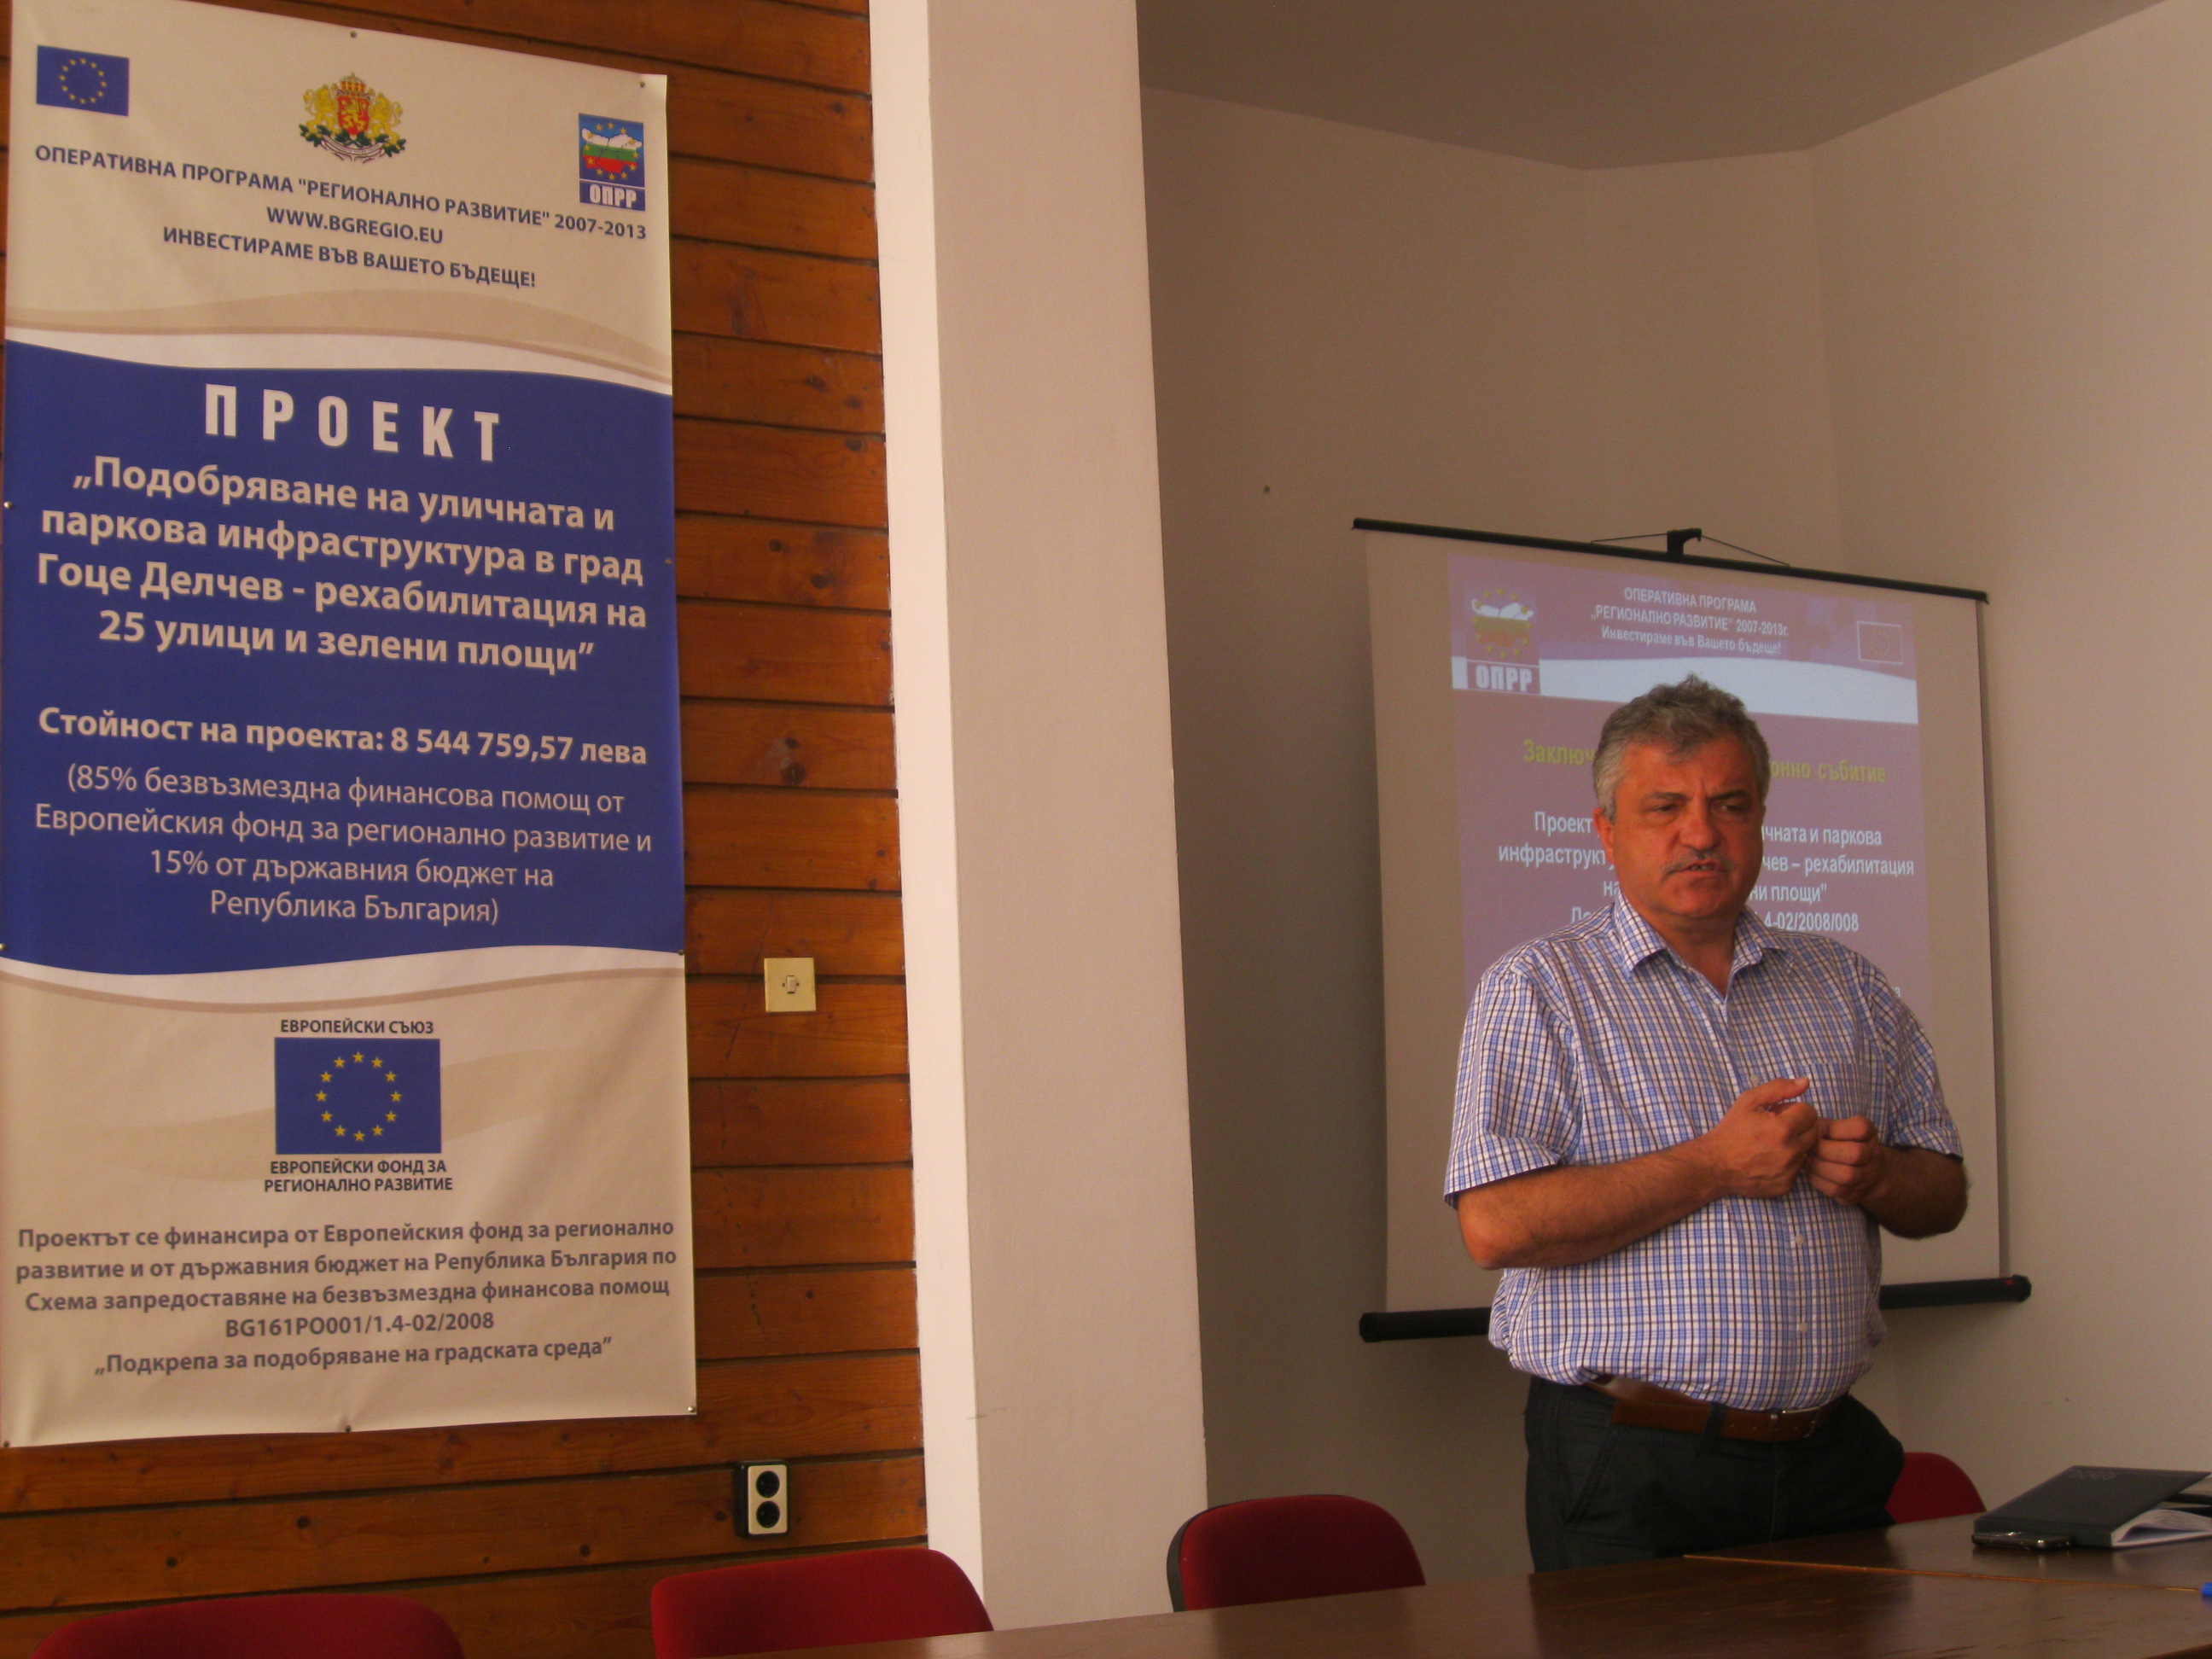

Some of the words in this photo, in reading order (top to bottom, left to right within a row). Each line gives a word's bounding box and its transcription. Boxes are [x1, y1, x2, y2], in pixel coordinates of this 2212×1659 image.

[35, 145, 176, 178] ОПЕРАТИВНА
[183, 163, 294, 193] ПРОГРАМА
[555, 214, 646, 240] 2007-2013
[590, 183, 637, 208] ОПРР
[267, 207, 443, 244] WWW.BGREGIO.EU
[164, 226, 313, 260] ИНВЕСТИРАМЕ
[319, 246, 358, 265] ВЪВ
[364, 252, 445, 276] ВАШЕТО
[450, 262, 535, 288] БЪДЕЩЕ!
[368, 488, 409, 513] на
[418, 492, 584, 527] уличната
[595, 509, 614, 531] и
[43, 510, 207, 545] паркова
[218, 521, 525, 575] инфраструктура
[536, 551, 555, 573] в
[565, 553, 643, 586] град
[38, 553, 131, 595] Гоце
[140, 562, 283, 601] Делчев
[316, 581, 597, 627] рехабилитация
[608, 604, 646, 627] на
[1624, 587, 1697, 608] ОПЕРАТИВНА
[1699, 595, 1757, 614] ПРОГРАМА
[99, 610, 144, 642] 25
[155, 620, 274, 655] улици
[286, 630, 306, 653] и
[317, 632, 446, 662] зелени
[1602, 626, 1673, 646] Инвестираме
[1674, 635, 1694, 646] във
[1697, 634, 1736, 650] Вашето
[1476, 665, 1532, 692] ОПРР
[39, 707, 193, 740] Стойност
[201, 722, 237, 743] на
[247, 725, 383, 752] проекта:
[391, 727, 408, 752] 8
[416, 729, 470, 754] 544
[478, 732, 573, 762] 759,57
[580, 743, 646, 764] лева
[1523, 739, 1595, 765] Заключ
[1770, 760, 1812, 780] онно
[1819, 760, 1888, 783] събитие
[68, 763, 137, 792] (85%
[145, 766, 341, 803] безвъзмездна
[348, 777, 493, 807] финансова
[502, 790, 590, 816] помощ
[597, 795, 624, 812] от
[36, 803, 223, 835] Европейския
[231, 811, 304, 843] фонд
[311, 821, 338, 840] за
[347, 823, 506, 847] регионално
[514, 830, 629, 853] развитие
[637, 835, 651, 852] и
[1534, 812, 1592, 836] Проект
[1761, 826, 1807, 842] чната
[1810, 829, 1819, 842] и
[1824, 829, 1882, 848] паркова
[151, 849, 208, 875] 15%
[216, 857, 247, 876] от
[253, 859, 408, 884] държавния
[416, 858, 517, 888] бюджет
[525, 869, 553, 887] на
[1499, 842, 1615, 870] инфраструкт
[1762, 855, 1788, 871] чев
[1805, 855, 1914, 877] рехабилитация
[211, 889, 356, 923] Република
[365, 894, 498, 927] България)
[1764, 911, 1860, 931] 4-02/2008/008
[281, 1017, 385, 1033] ЕВРОПЕЙСКИ
[388, 1021, 434, 1033] СЪЮЗ
[271, 1158, 373, 1174] ЕВРОПЕЙСКИ
[377, 1161, 424, 1174] ФОНД
[428, 1160, 447, 1173] ЗА
[265, 1179, 371, 1192] РЕГИОНАЛНО
[375, 1178, 452, 1191] РАЗВИТИЕ
[19, 1229, 130, 1252] Проектът
[136, 1231, 159, 1246] се
[165, 1226, 288, 1249] финансира
[294, 1229, 318, 1243] от
[324, 1223, 463, 1246] Европейския
[469, 1221, 523, 1243] фонд
[528, 1225, 550, 1238] за
[556, 1222, 673, 1242] регионално
[16, 1264, 125, 1284] развитие
[131, 1264, 143, 1277] и
[149, 1263, 175, 1277] от
[180, 1260, 309, 1280] държавния
[314, 1254, 399, 1276] бюджет
[405, 1258, 428, 1271] на
[435, 1251, 545, 1273] Република
[551, 1250, 647, 1270] България
[653, 1251, 677, 1264] по
[26, 1293, 97, 1312] Схема
[104, 1291, 287, 1313] запредоставяне
[293, 1290, 317, 1304] на
[323, 1285, 476, 1304] безвъзмездна
[481, 1281, 594, 1303] финансова
[600, 1281, 670, 1296] помощ
[226, 1312, 494, 1337] BG161PO001/1.4-02/2008
[224, 1354, 247, 1369] за
[253, 1348, 400, 1370] подобряване
[405, 1348, 429, 1362] на
[435, 1344, 538, 1365] градската
